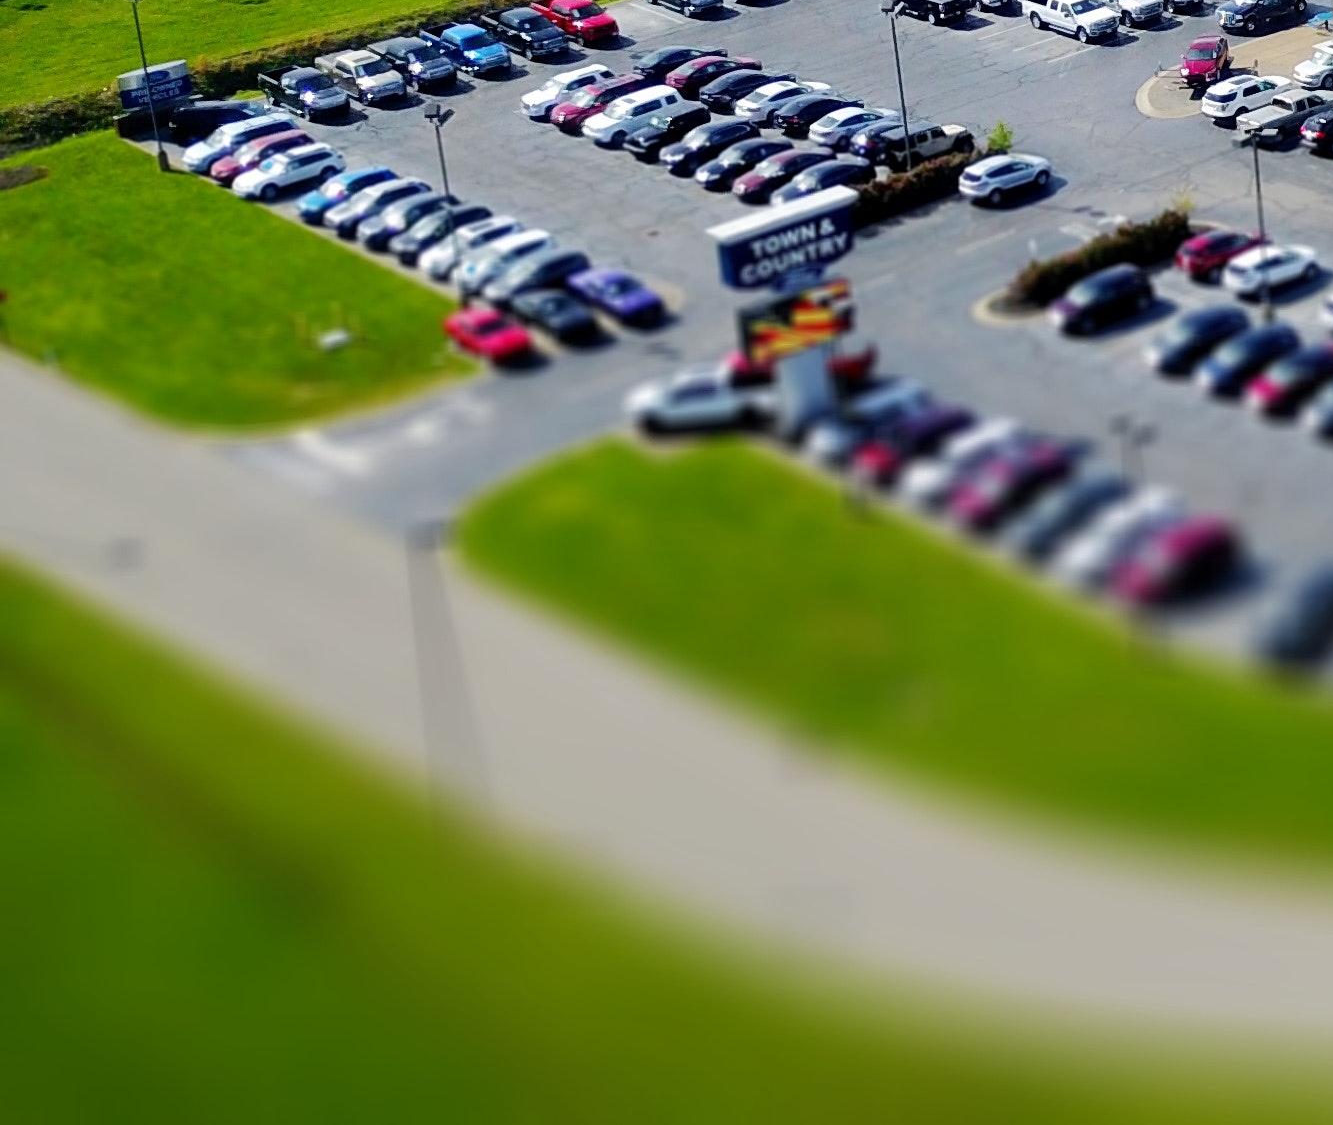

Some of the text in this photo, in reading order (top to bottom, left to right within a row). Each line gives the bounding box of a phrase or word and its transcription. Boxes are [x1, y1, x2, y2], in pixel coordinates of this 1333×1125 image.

[741, 232, 847, 282] COUNTRY
[750, 218, 835, 257] TOWN &
